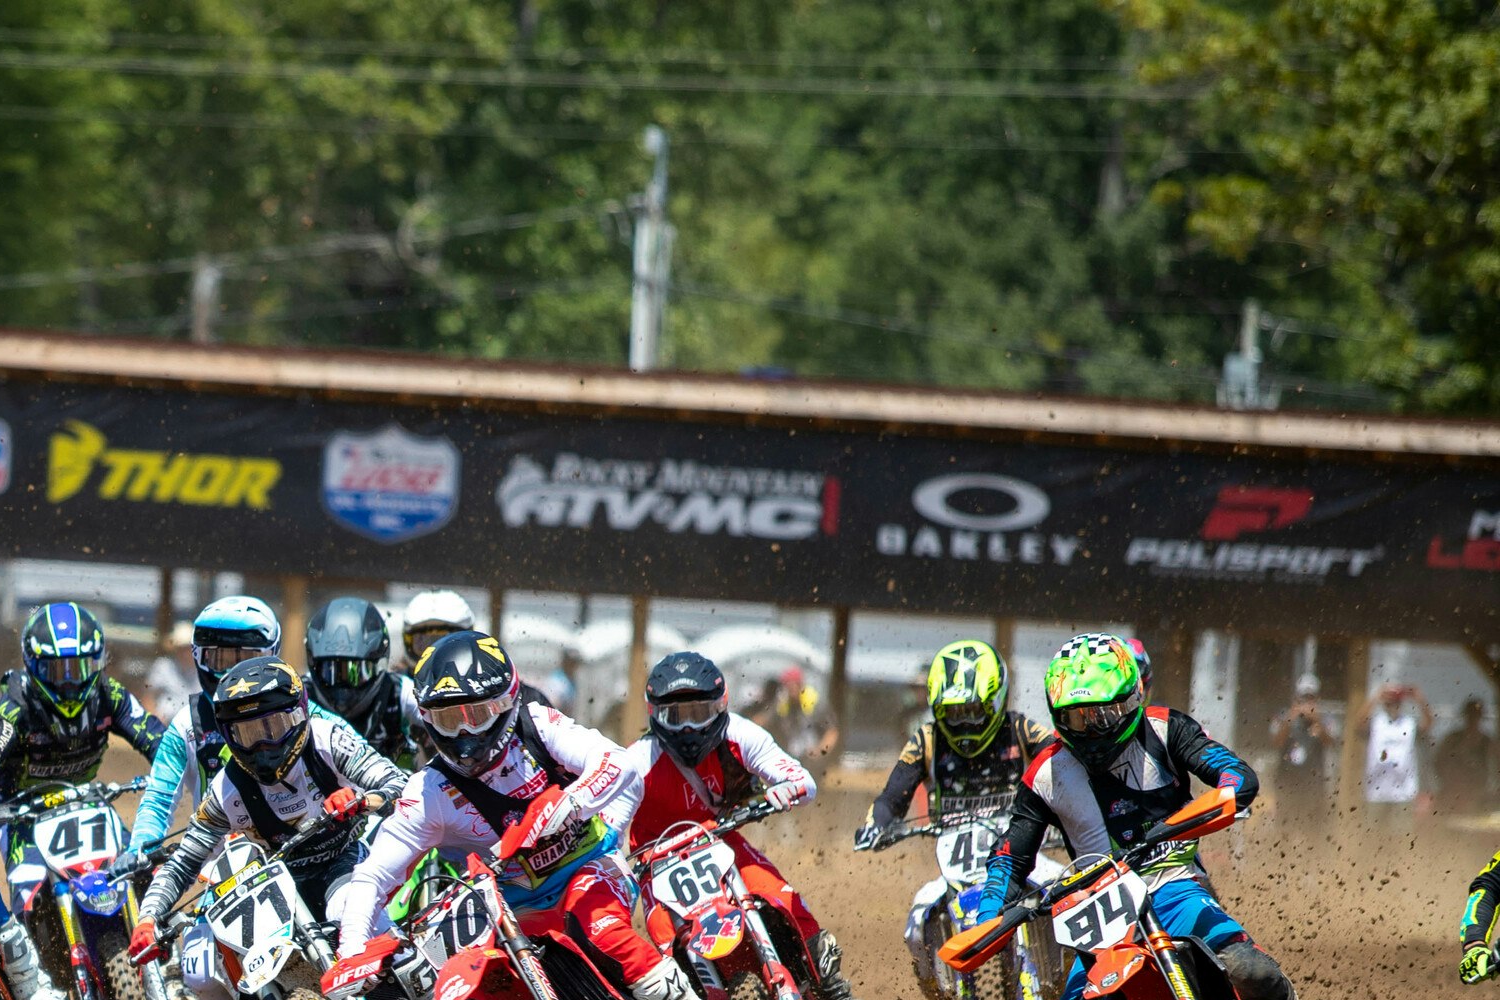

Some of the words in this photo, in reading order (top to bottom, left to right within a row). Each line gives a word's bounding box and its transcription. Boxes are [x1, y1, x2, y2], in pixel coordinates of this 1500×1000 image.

[103, 450, 282, 508] THOR
[876, 525, 1081, 567] OAKLEY
[1125, 537, 1375, 578] POLISPORT
[1069, 689, 1091, 698] SHOEI
[48, 811, 108, 861] 41
[529, 805, 552, 846] UFO
[668, 852, 723, 908] 65
[1064, 882, 1138, 951] 94
[332, 962, 371, 988] UFO
[1459, 953, 1480, 973] FOX
